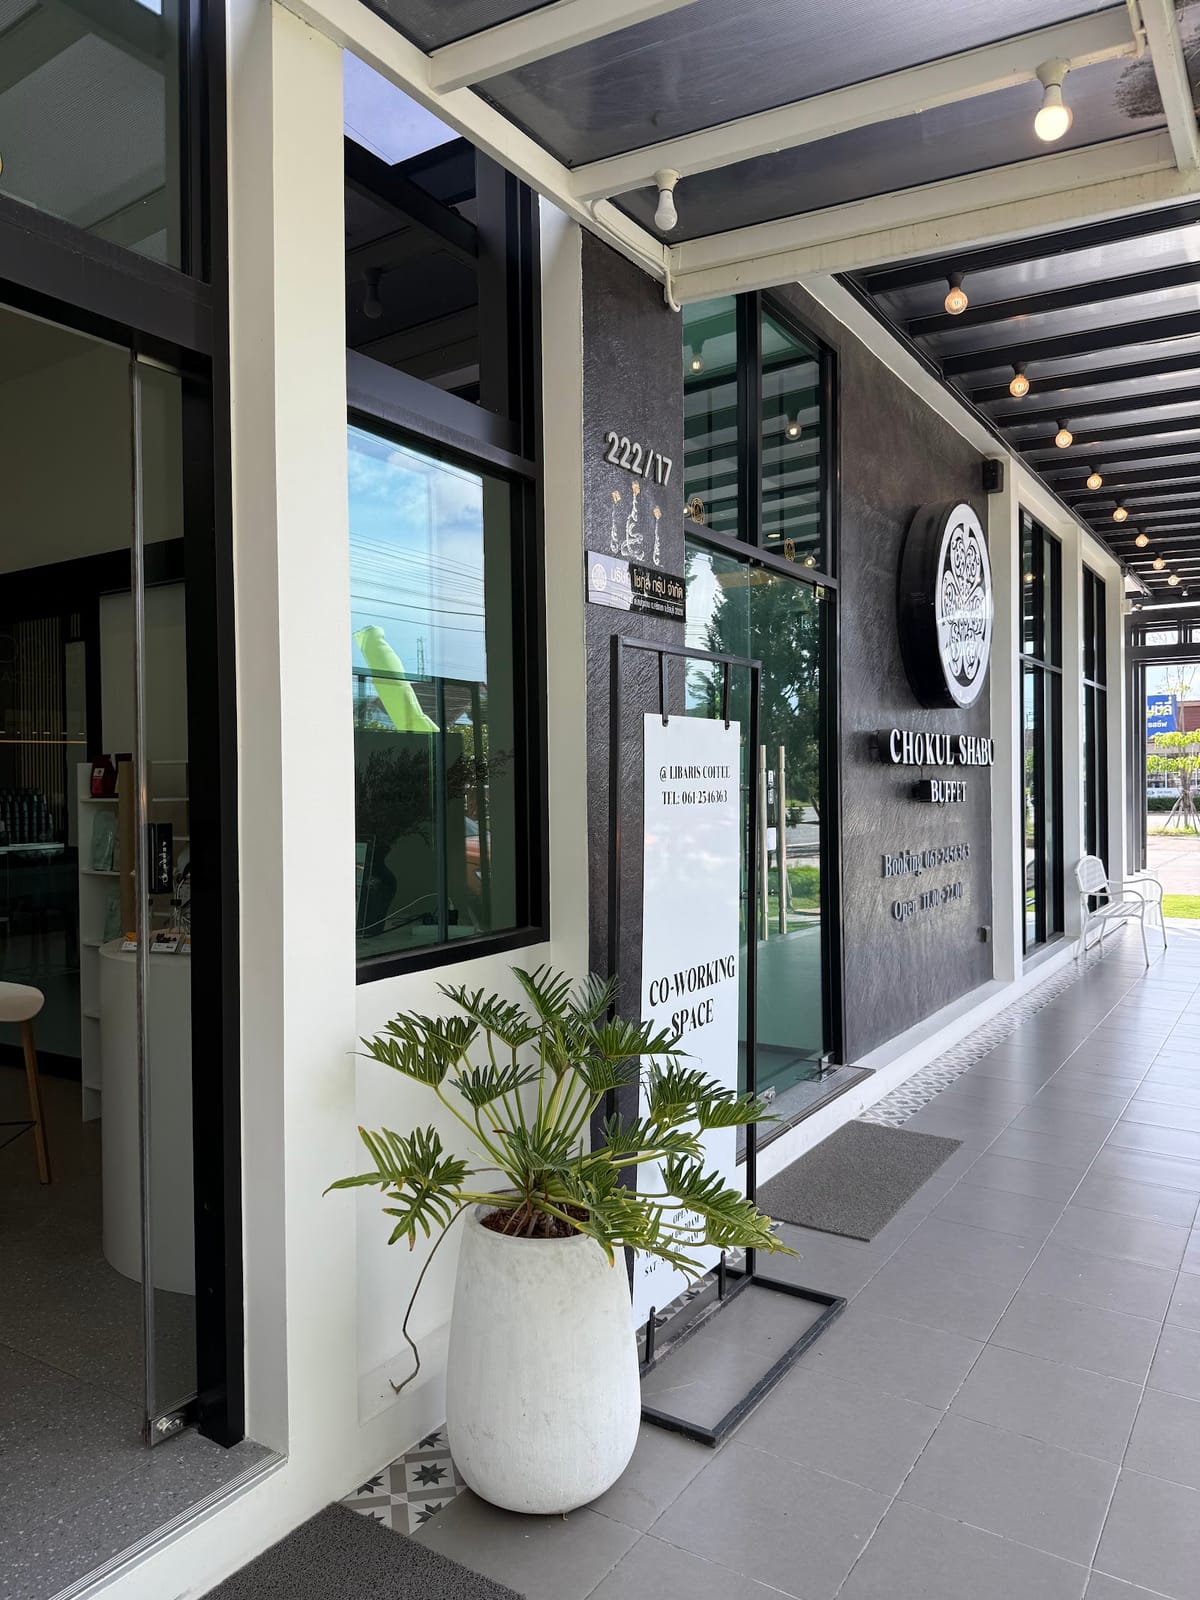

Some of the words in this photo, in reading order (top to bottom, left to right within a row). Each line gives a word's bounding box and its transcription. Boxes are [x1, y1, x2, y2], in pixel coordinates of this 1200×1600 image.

[606, 431, 673, 486] 222/17
[890, 728, 955, 766] CHOKUL
[958, 734, 995, 766] SHABU
[659, 766, 667, 782] @
[669, 765, 701, 780] LIBARIS
[702, 765, 731, 779] COFFEE
[662, 791, 680, 805] TEL:
[930, 779, 967, 803] BUFFET
[884, 850, 923, 879] Booking
[894, 899, 918, 923] Open
[649, 954, 735, 1007] CO-WORKING
[671, 998, 714, 1038] SPACE
